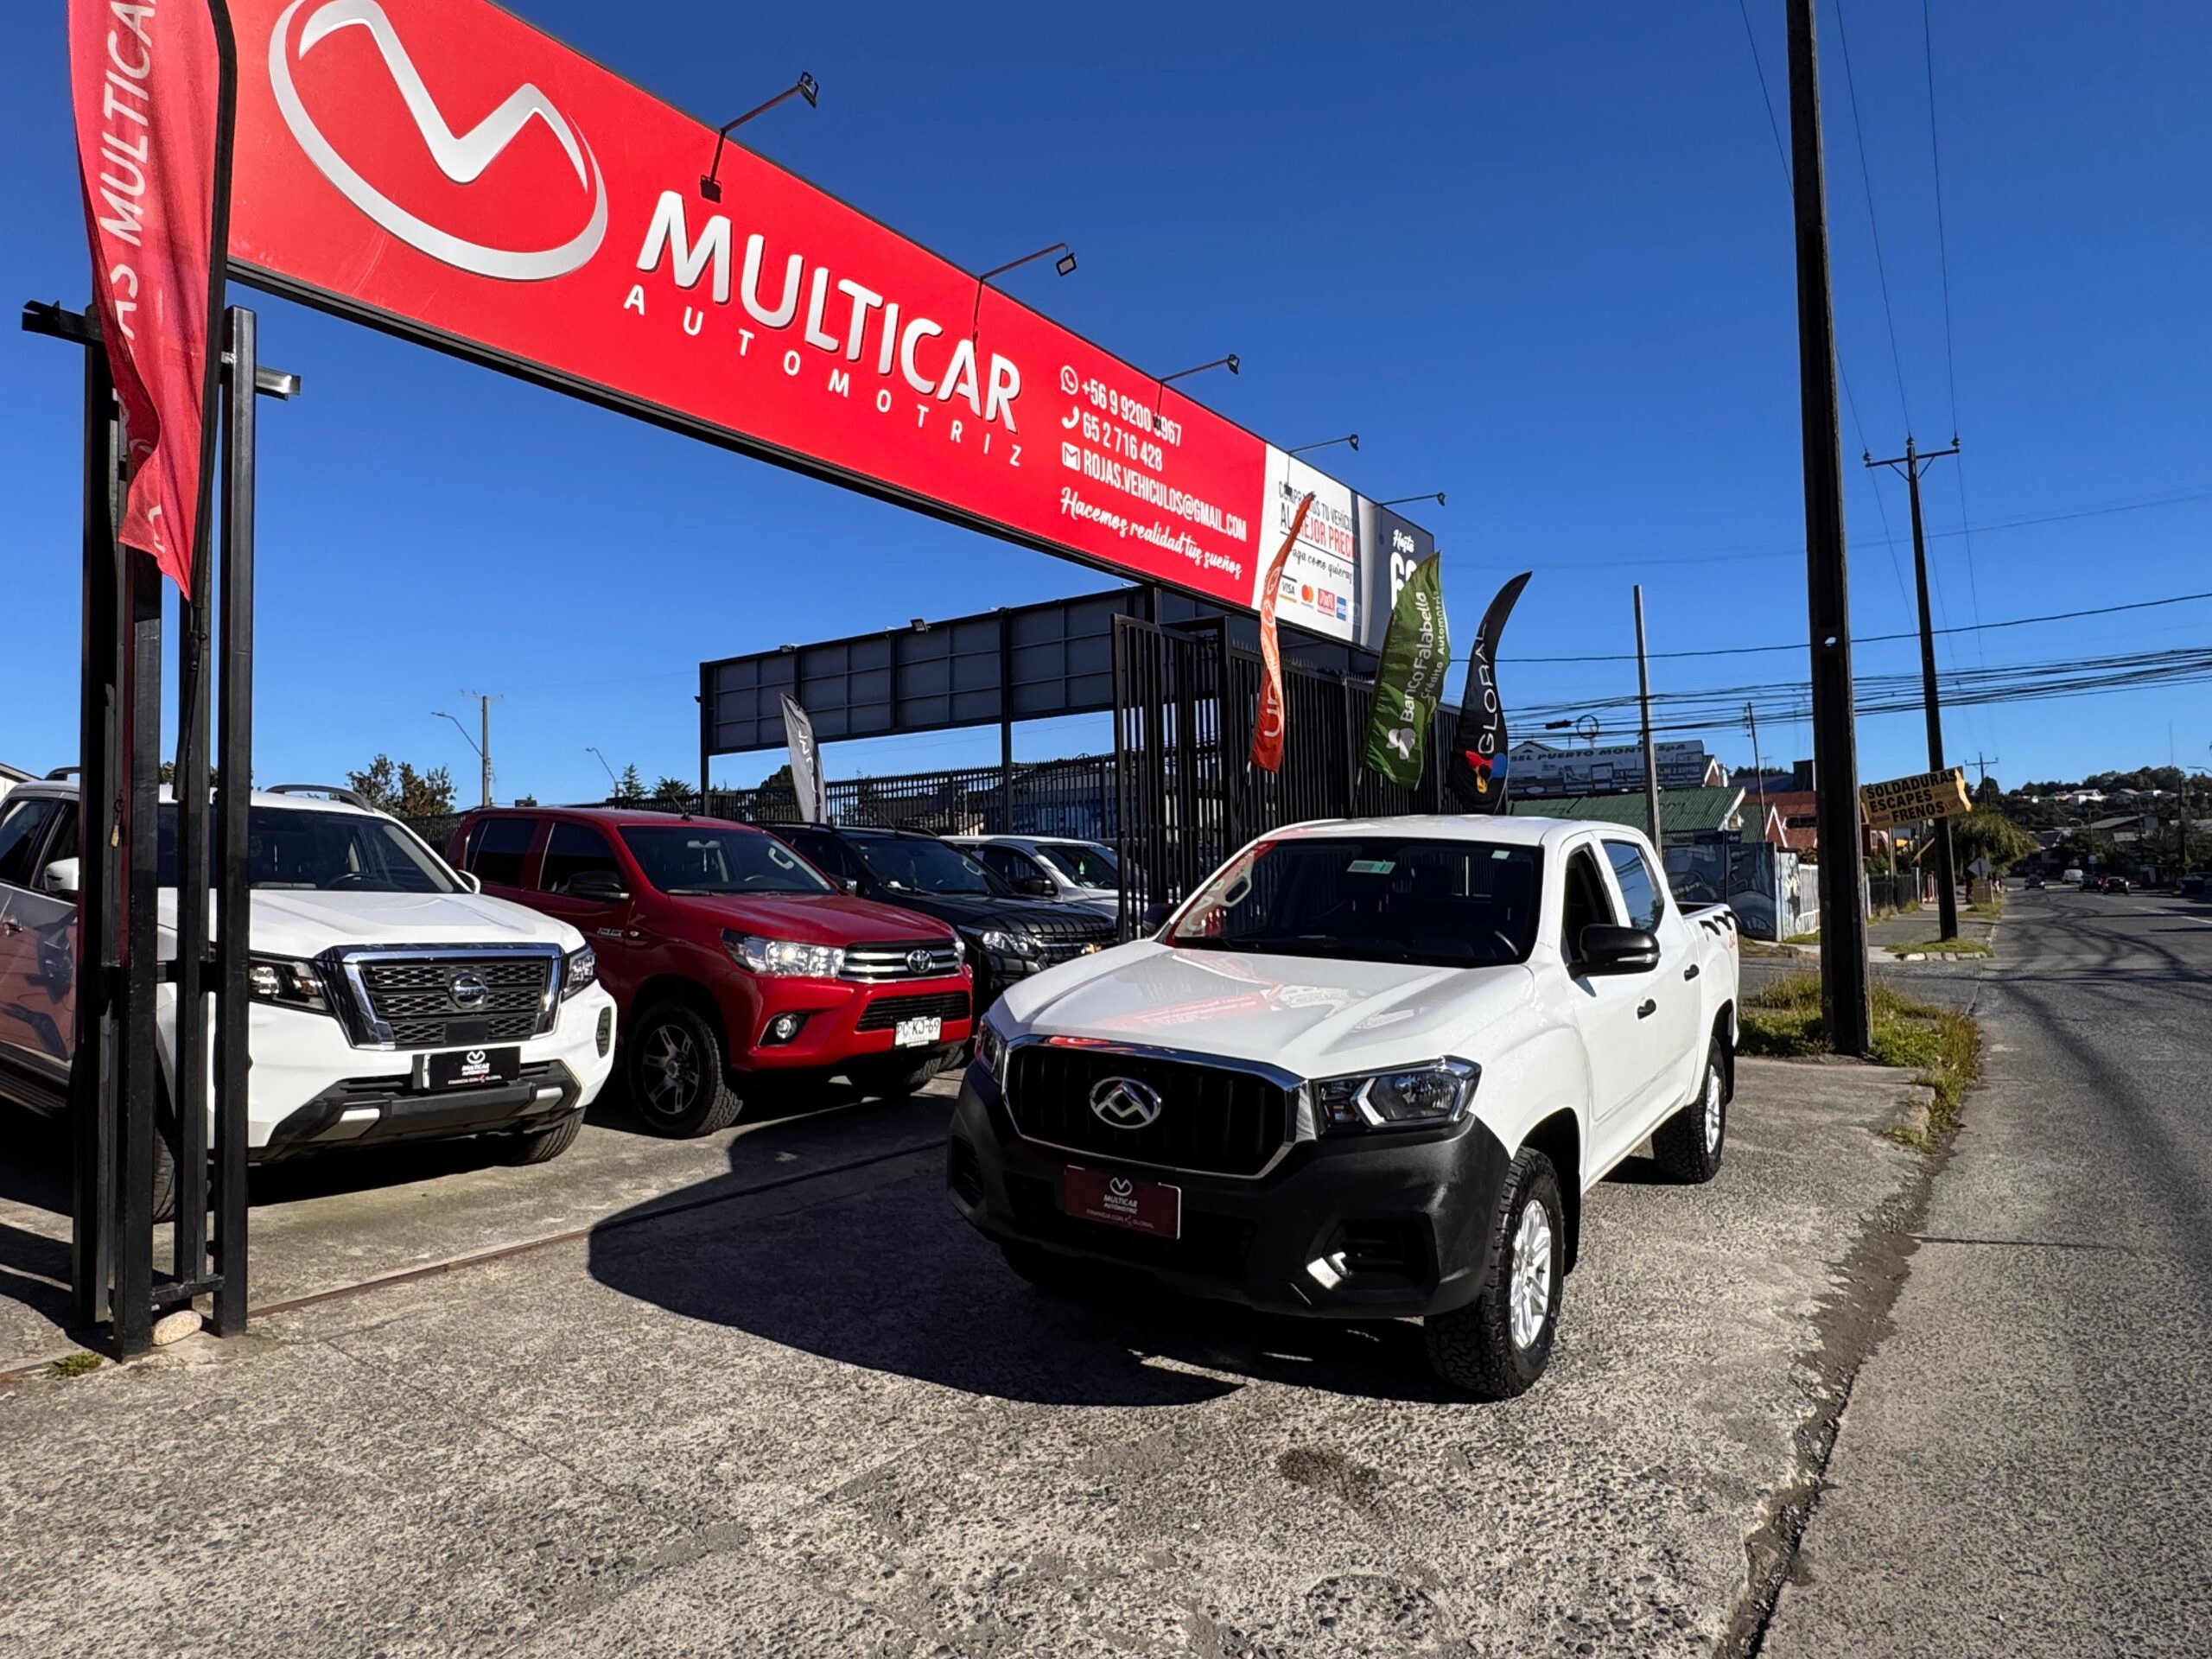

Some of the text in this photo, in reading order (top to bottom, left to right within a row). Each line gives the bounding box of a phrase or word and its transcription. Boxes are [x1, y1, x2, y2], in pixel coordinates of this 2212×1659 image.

[99, 0, 156, 248] MULTICA
[636, 190, 1021, 434] MULTICAR
[624, 284, 1023, 467] AUTOMOTRIZ
[1082, 378, 1107, 410] +56
[1109, 389, 1118, 416] 9
[1121, 395, 1152, 432] 9200
[1083, 411, 1162, 472] 65 2 716 428
[1084, 448, 1247, 543] ROJAS.VEHICULOS@GMAIL.COM
[1281, 501, 1293, 531] AL
[1060, 486, 1243, 581] Hacemos realidad tus sueños
[1393, 529, 1414, 553] Hasta
[1293, 548, 1306, 569] aga
[1281, 582, 1295, 595] VISA
[1399, 591, 1433, 722] Banco Falabella
[1421, 661, 1443, 699] Crédito
[1536, 750, 1593, 761] PUERTO
[1866, 770, 1956, 799] SOLDADURAS
[1869, 789, 1933, 813] ESCAPES
[1891, 800, 1945, 823] FRENOS
[1103, 1194, 1138, 1207] MULTICAR
